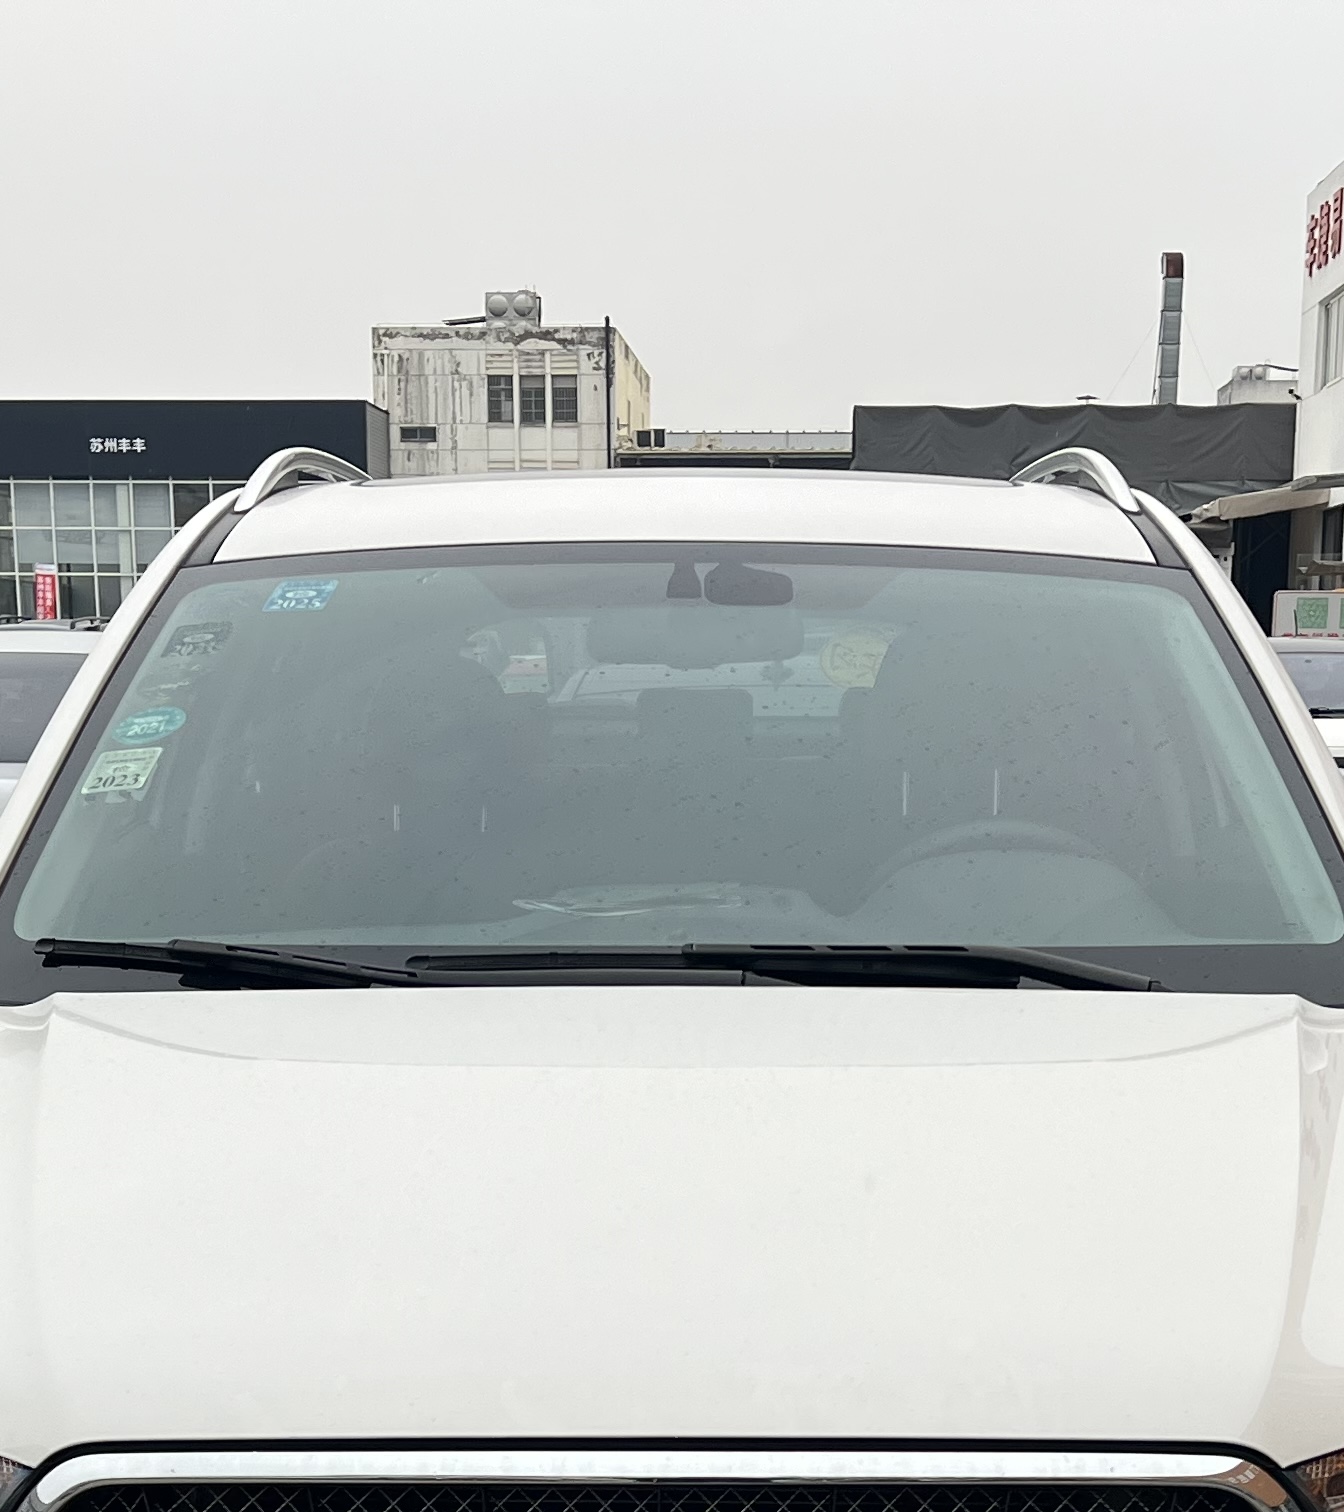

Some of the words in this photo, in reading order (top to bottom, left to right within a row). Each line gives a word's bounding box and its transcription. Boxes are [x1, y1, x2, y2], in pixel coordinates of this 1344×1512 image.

[89, 437, 147, 453] 苏州丰丰
[269, 598, 323, 609] 2025
[88, 773, 141, 789] 2023
